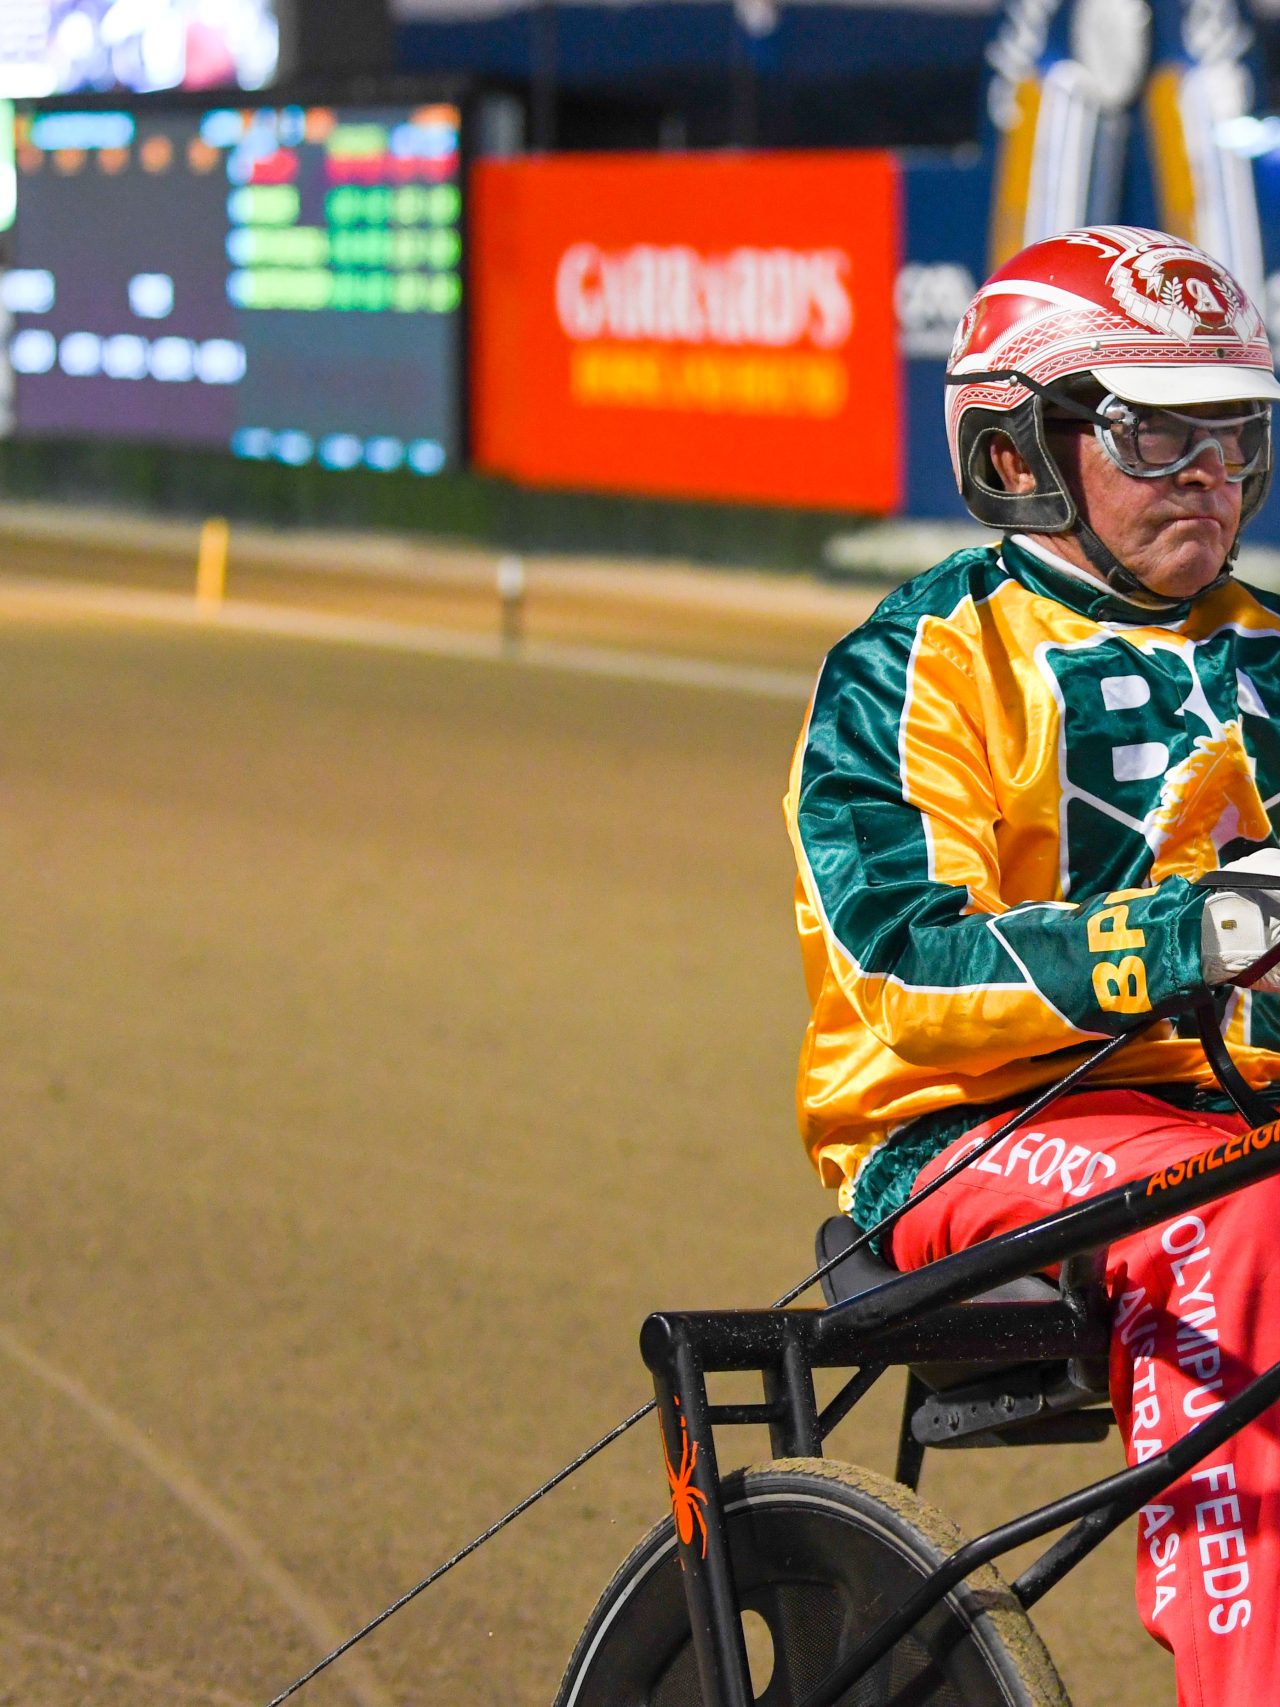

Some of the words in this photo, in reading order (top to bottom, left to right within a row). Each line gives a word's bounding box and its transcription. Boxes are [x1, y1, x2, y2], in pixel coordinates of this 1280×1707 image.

[1161, 1215, 1226, 1433] OLYMPU
[1113, 1286, 1179, 1622] AUSTRAASIA
[1191, 1463, 1252, 1635] FEEDS
